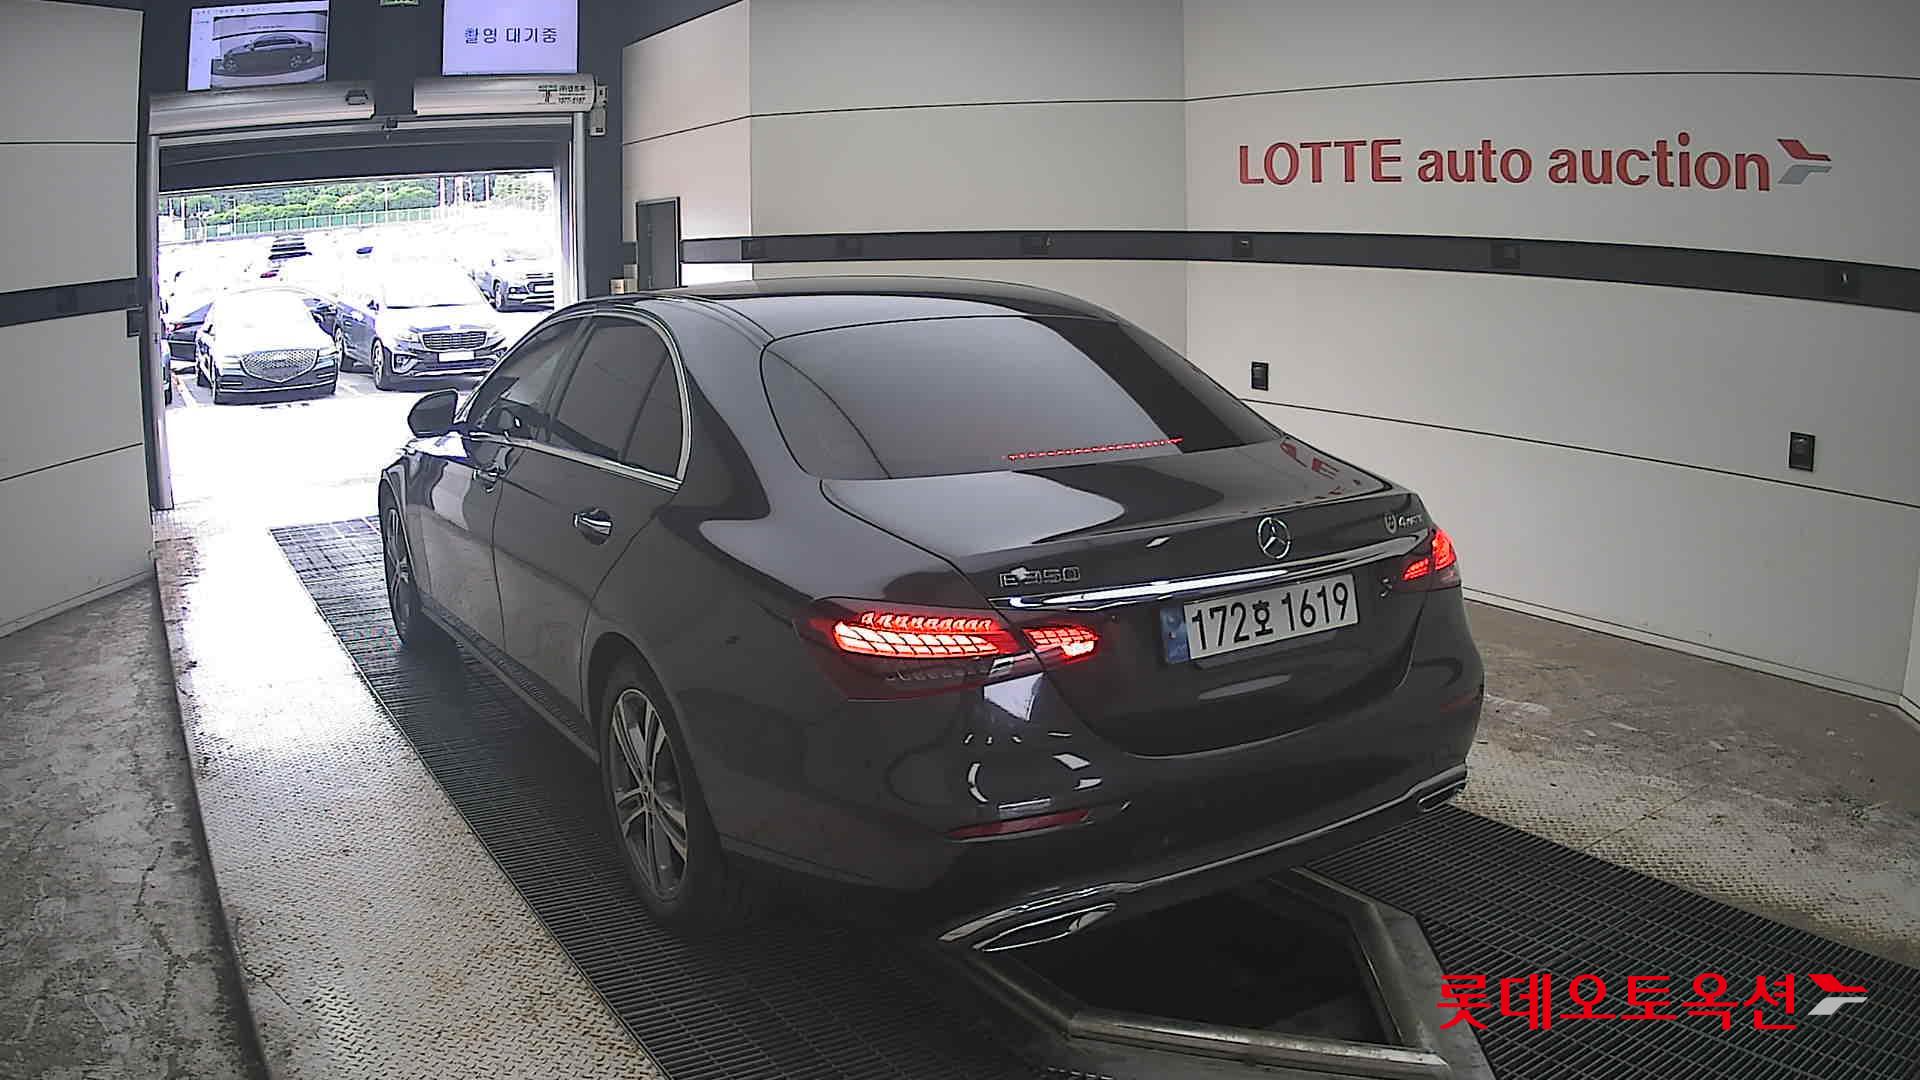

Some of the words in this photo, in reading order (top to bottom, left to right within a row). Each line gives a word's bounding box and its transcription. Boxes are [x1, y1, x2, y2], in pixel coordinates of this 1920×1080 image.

[505, 27, 558, 44] 대기중
[1239, 139, 1402, 185] LOTTE
[1417, 140, 1533, 184] auto
[1548, 132, 1771, 191] auction
[1192, 600, 1274, 650] 172호
[1281, 582, 1349, 631] 1619
